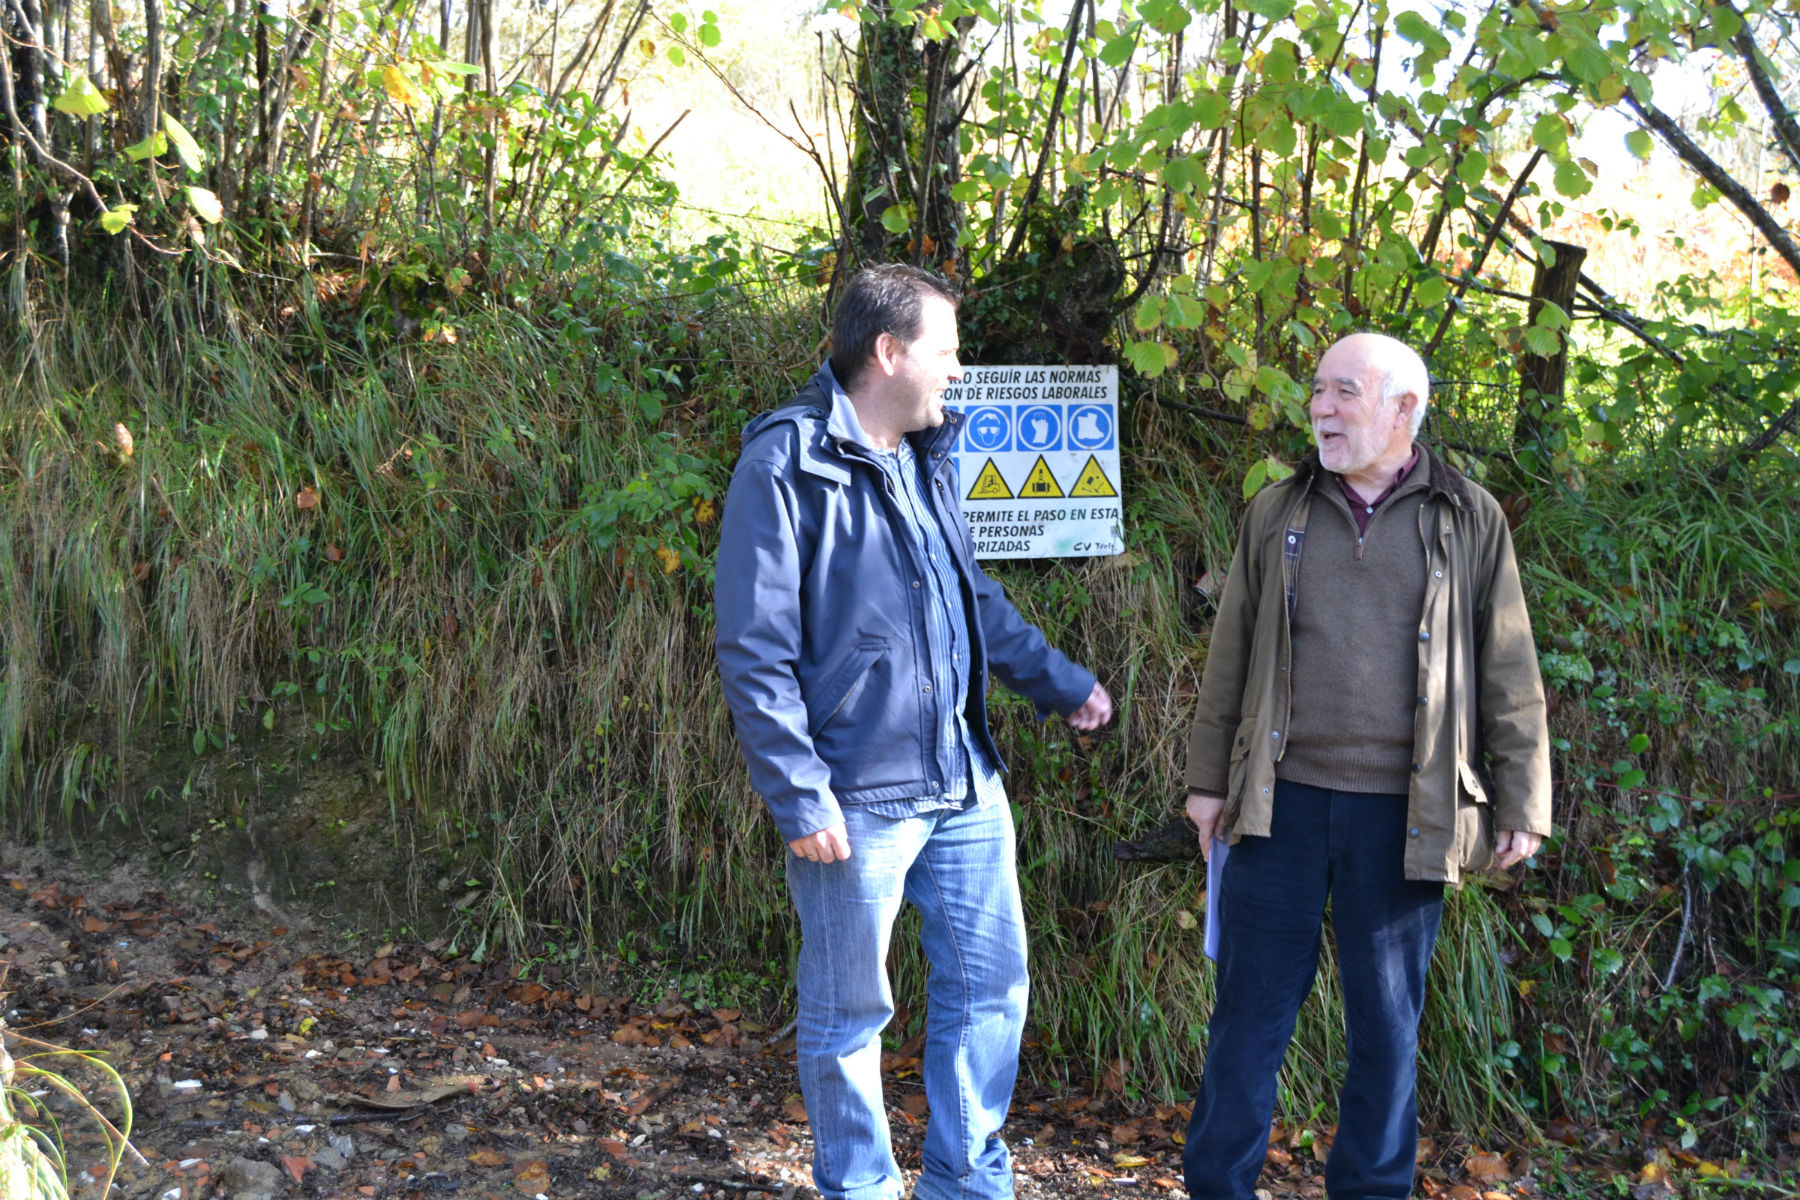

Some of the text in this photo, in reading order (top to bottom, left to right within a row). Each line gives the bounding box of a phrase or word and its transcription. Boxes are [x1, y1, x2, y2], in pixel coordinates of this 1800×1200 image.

[1025, 370, 1046, 384] LAS
[1049, 370, 1101, 384] NORMAS
[940, 386, 1107, 401] ON DE RIESGOS LABORALES
[963, 508, 1119, 523] PERMITE EL PASO EN ESTA
[979, 525, 1045, 537] PERSONAS
